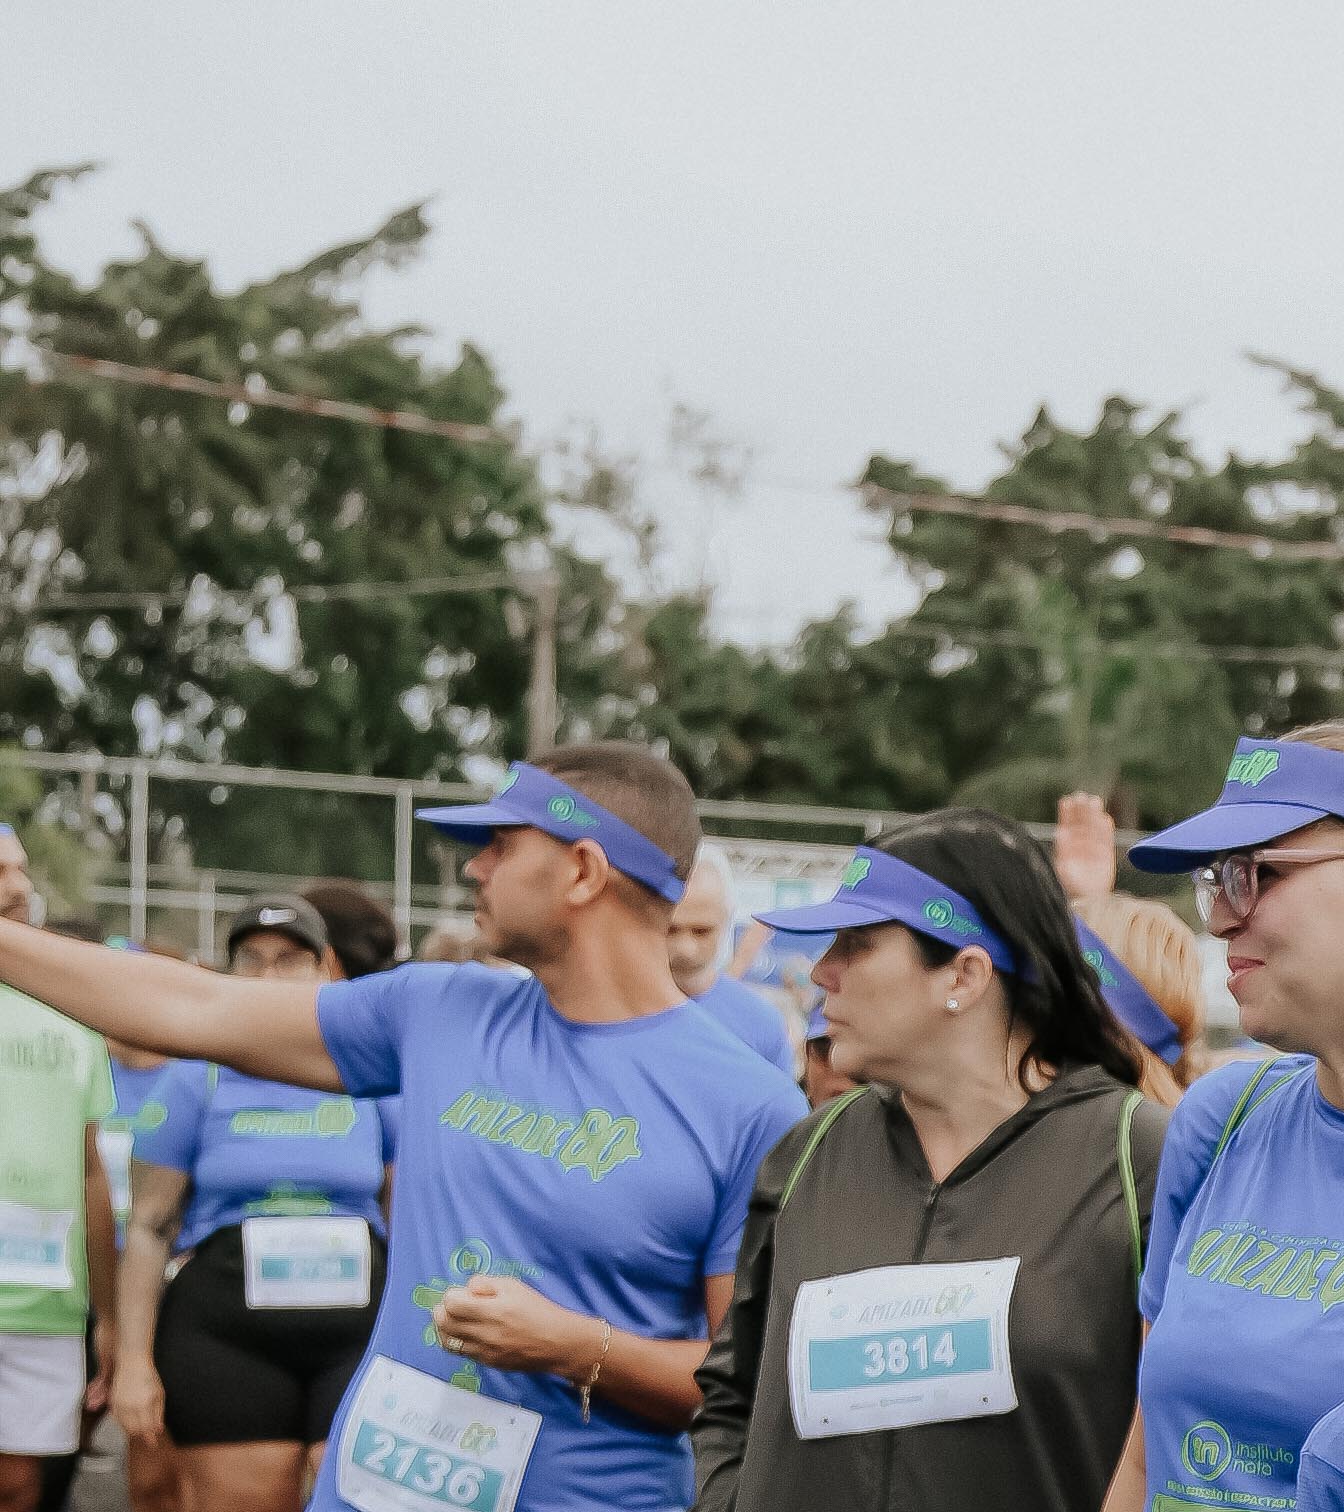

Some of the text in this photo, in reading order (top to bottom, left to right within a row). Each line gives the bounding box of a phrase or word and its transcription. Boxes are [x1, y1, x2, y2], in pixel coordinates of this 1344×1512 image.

[439, 1091, 576, 1158] AMIZADE
[862, 1331, 957, 1378] 3814
[363, 1430, 487, 1506] 2136
